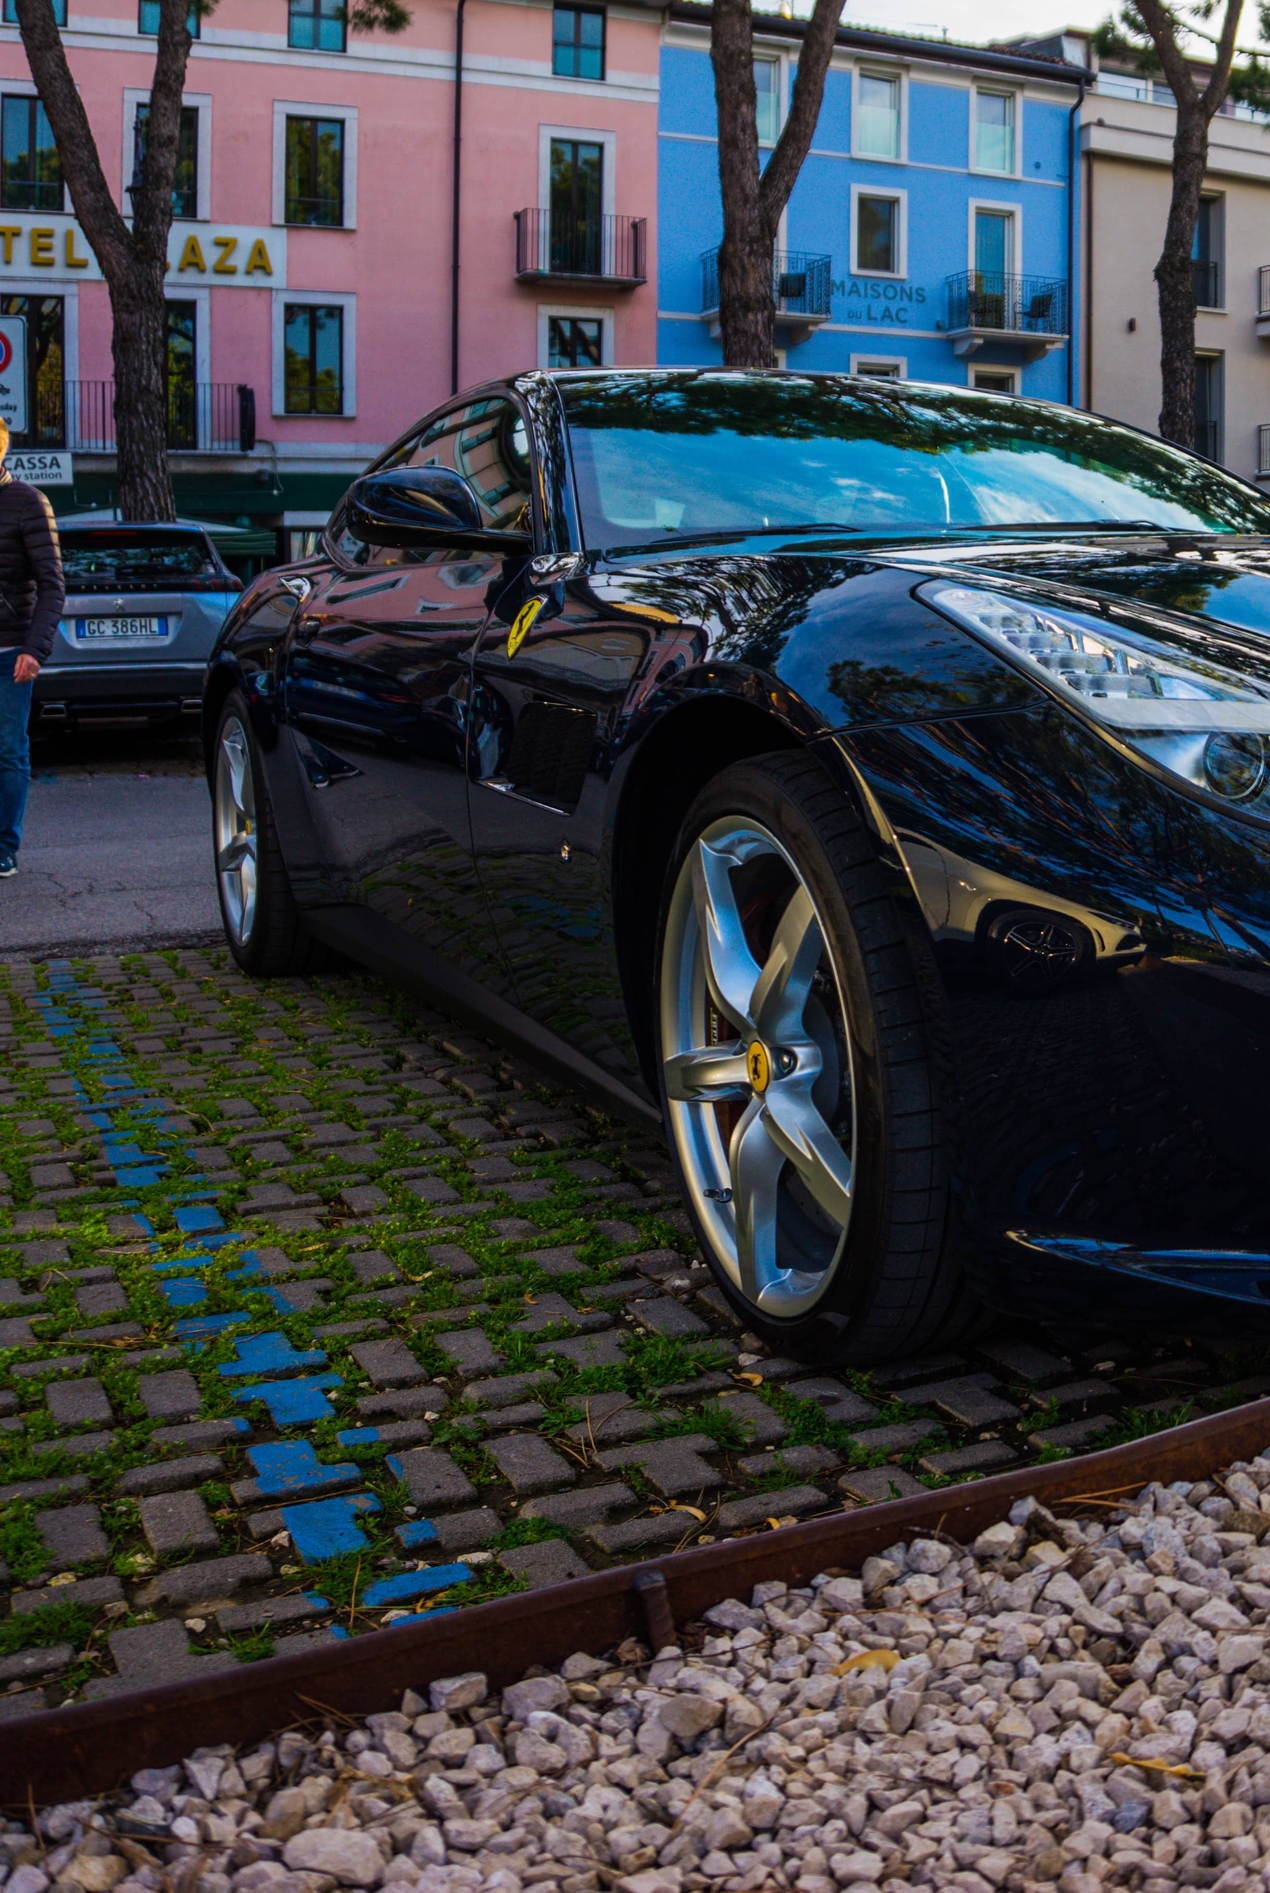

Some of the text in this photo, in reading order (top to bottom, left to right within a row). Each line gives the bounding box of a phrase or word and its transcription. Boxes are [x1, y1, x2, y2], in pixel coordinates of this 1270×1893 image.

[165, 235, 273, 275] AZA
[830, 279, 926, 303] MAISONS
[847, 304, 908, 324] DU LAC
[2, 456, 61, 470] CASSA
[25, 471, 62, 480] station
[87, 618, 158, 635] GC 386HL
